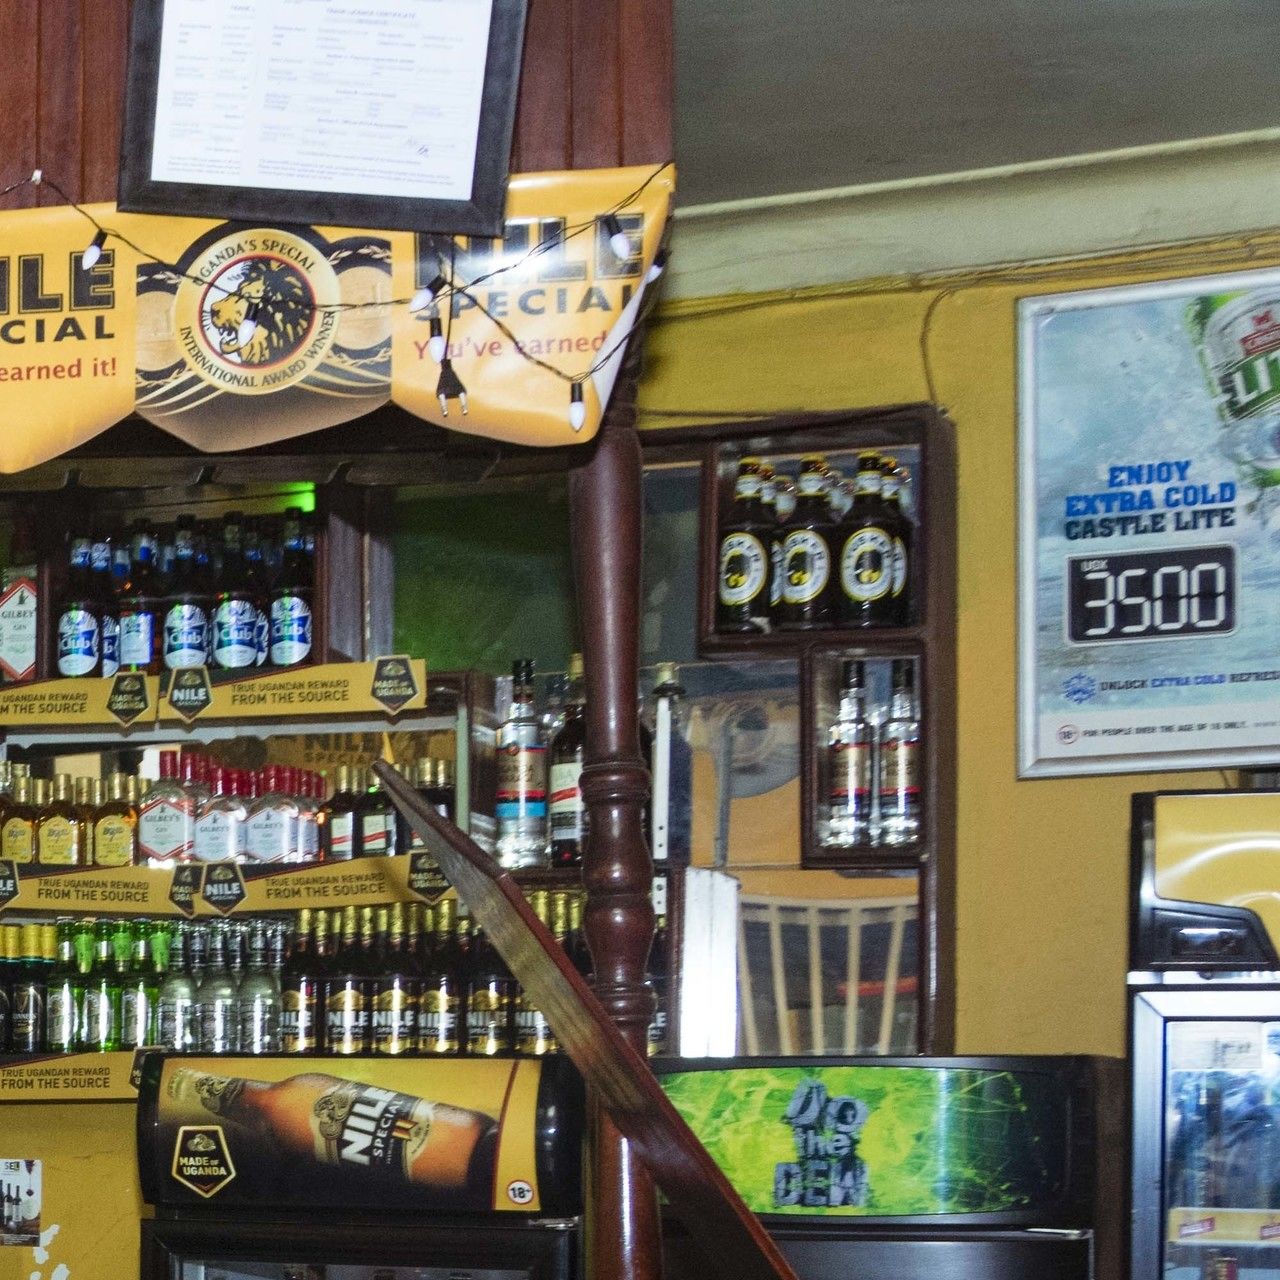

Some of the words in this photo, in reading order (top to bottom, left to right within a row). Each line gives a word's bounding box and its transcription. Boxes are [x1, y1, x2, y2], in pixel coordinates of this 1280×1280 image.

[194, 238, 258, 287] UGANDA'S
[262, 238, 316, 273] SPECIAL
[415, 214, 643, 290] NILE
[180, 325, 260, 388] INTERNATIONAL
[261, 356, 308, 388] AWARD
[304, 308, 337, 363] WINNER
[414, 333, 503, 360] Yu've
[92, 357, 117, 378] it!
[1109, 460, 1191, 488] ENJOY
[1066, 490, 1155, 517] EXTRA
[1165, 481, 1236, 508] COLD
[1064, 513, 1165, 540] CASTLE
[1175, 507, 1236, 531] LITE
[1085, 563, 1226, 636] 3500
[173, 689, 207, 701] NILE
[231, 693, 268, 705] FROM
[270, 692, 296, 704] THE
[298, 690, 349, 703] SOURCE
[341, 1087, 398, 1166] NILE
[373, 1099, 404, 1158] SPECIAL
[794, 1127, 851, 1158] the
[180, 1157, 209, 1165] MADE
[183, 1167, 227, 1175] UGANDA
[774, 1160, 869, 1206] DEW
